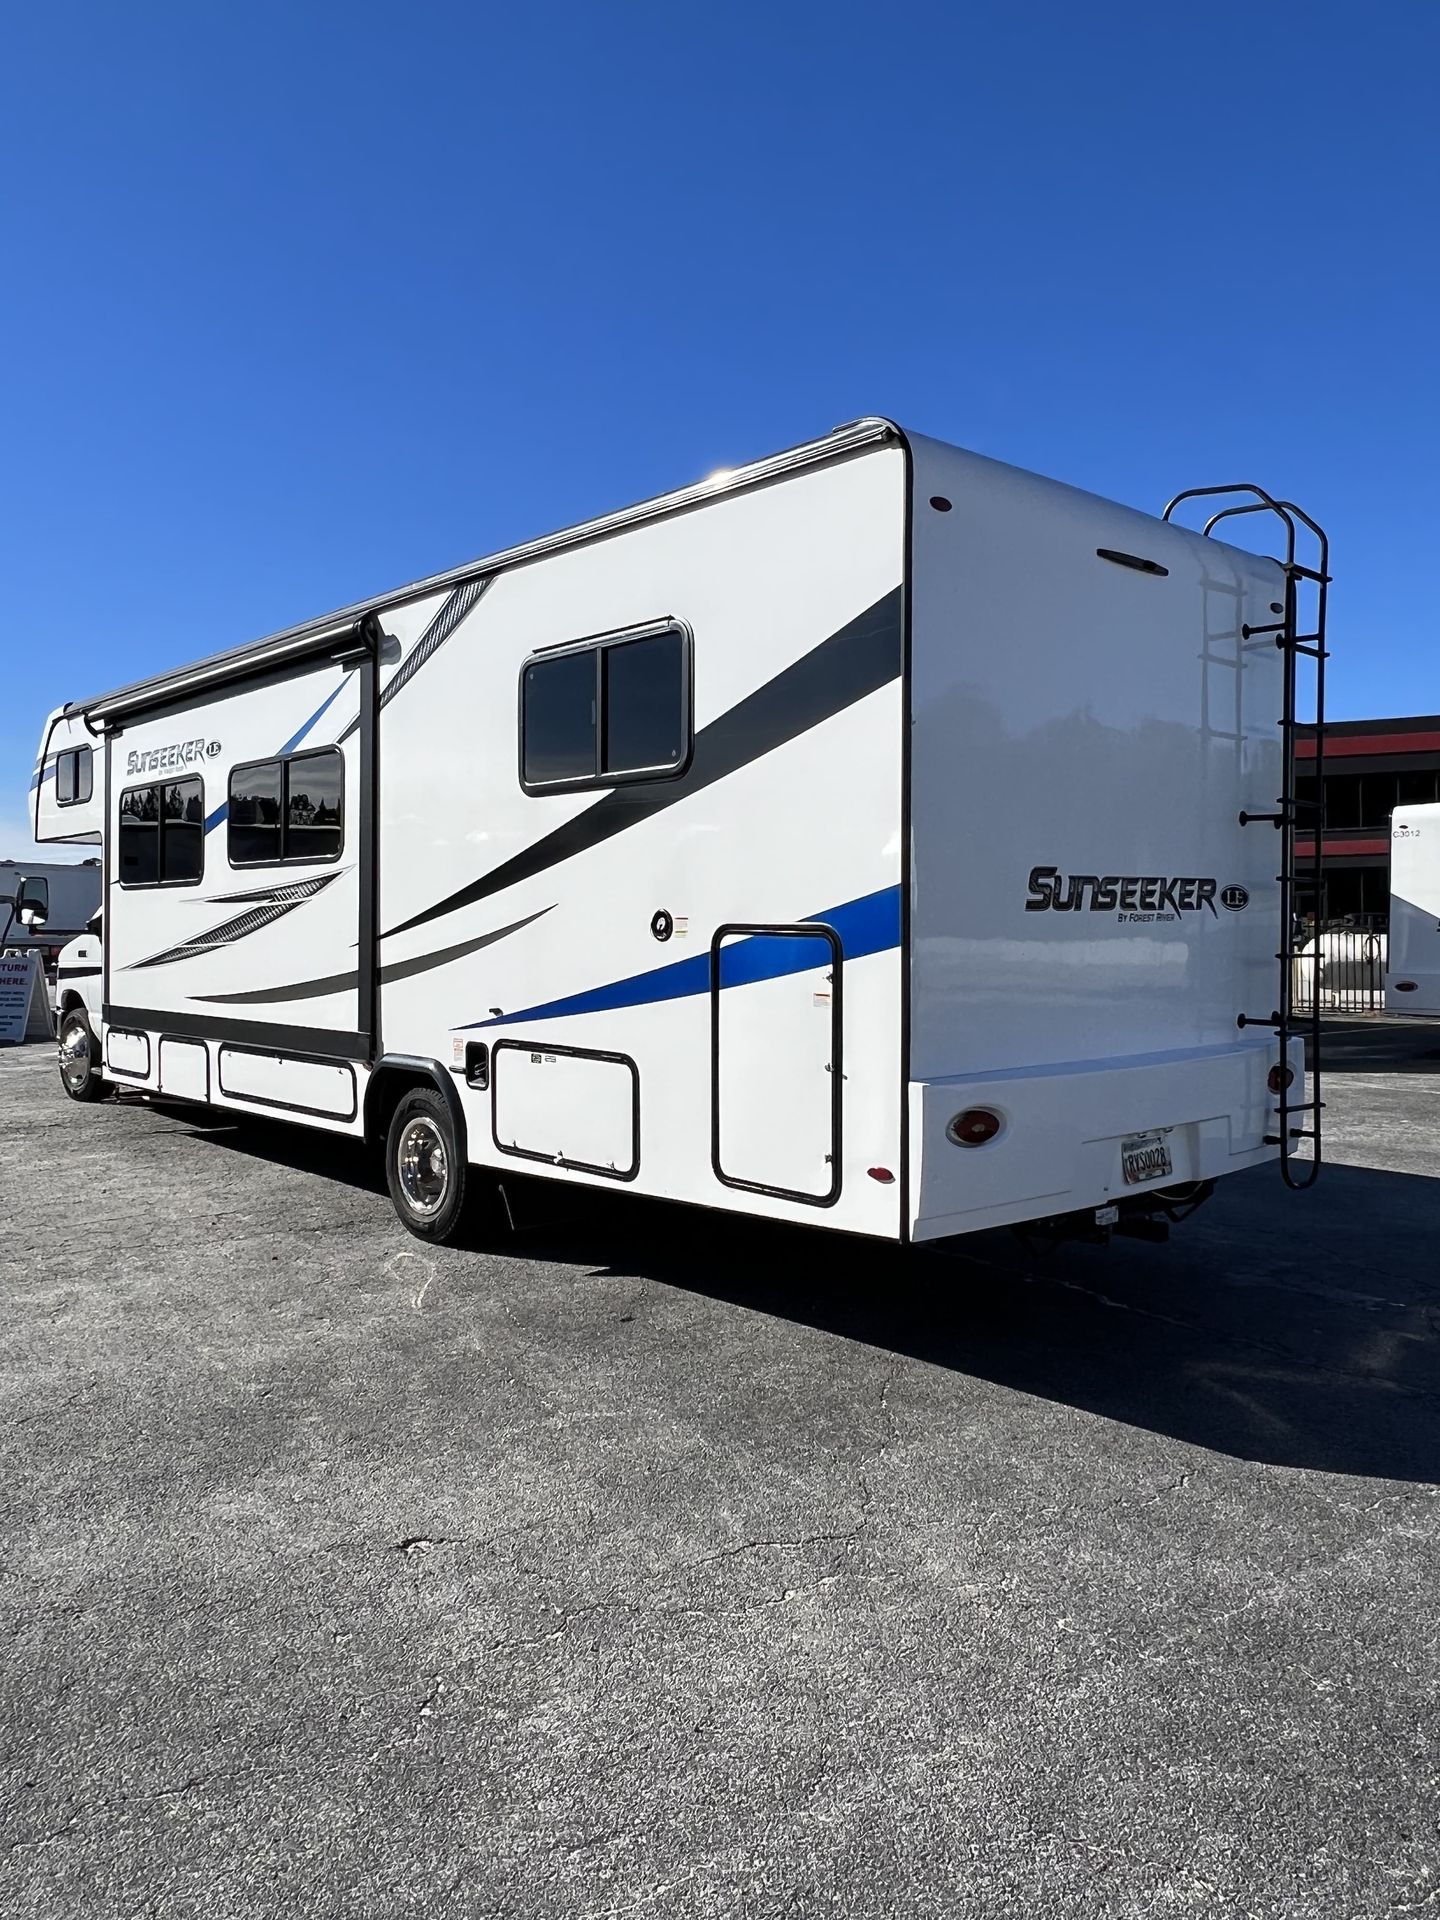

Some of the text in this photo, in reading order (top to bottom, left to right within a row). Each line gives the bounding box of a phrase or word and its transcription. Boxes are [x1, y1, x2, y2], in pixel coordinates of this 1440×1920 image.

[1128, 912, 1155, 922] FOREST
[1156, 912, 1175, 921] RIVER
[0, 963, 28, 972] TURN
